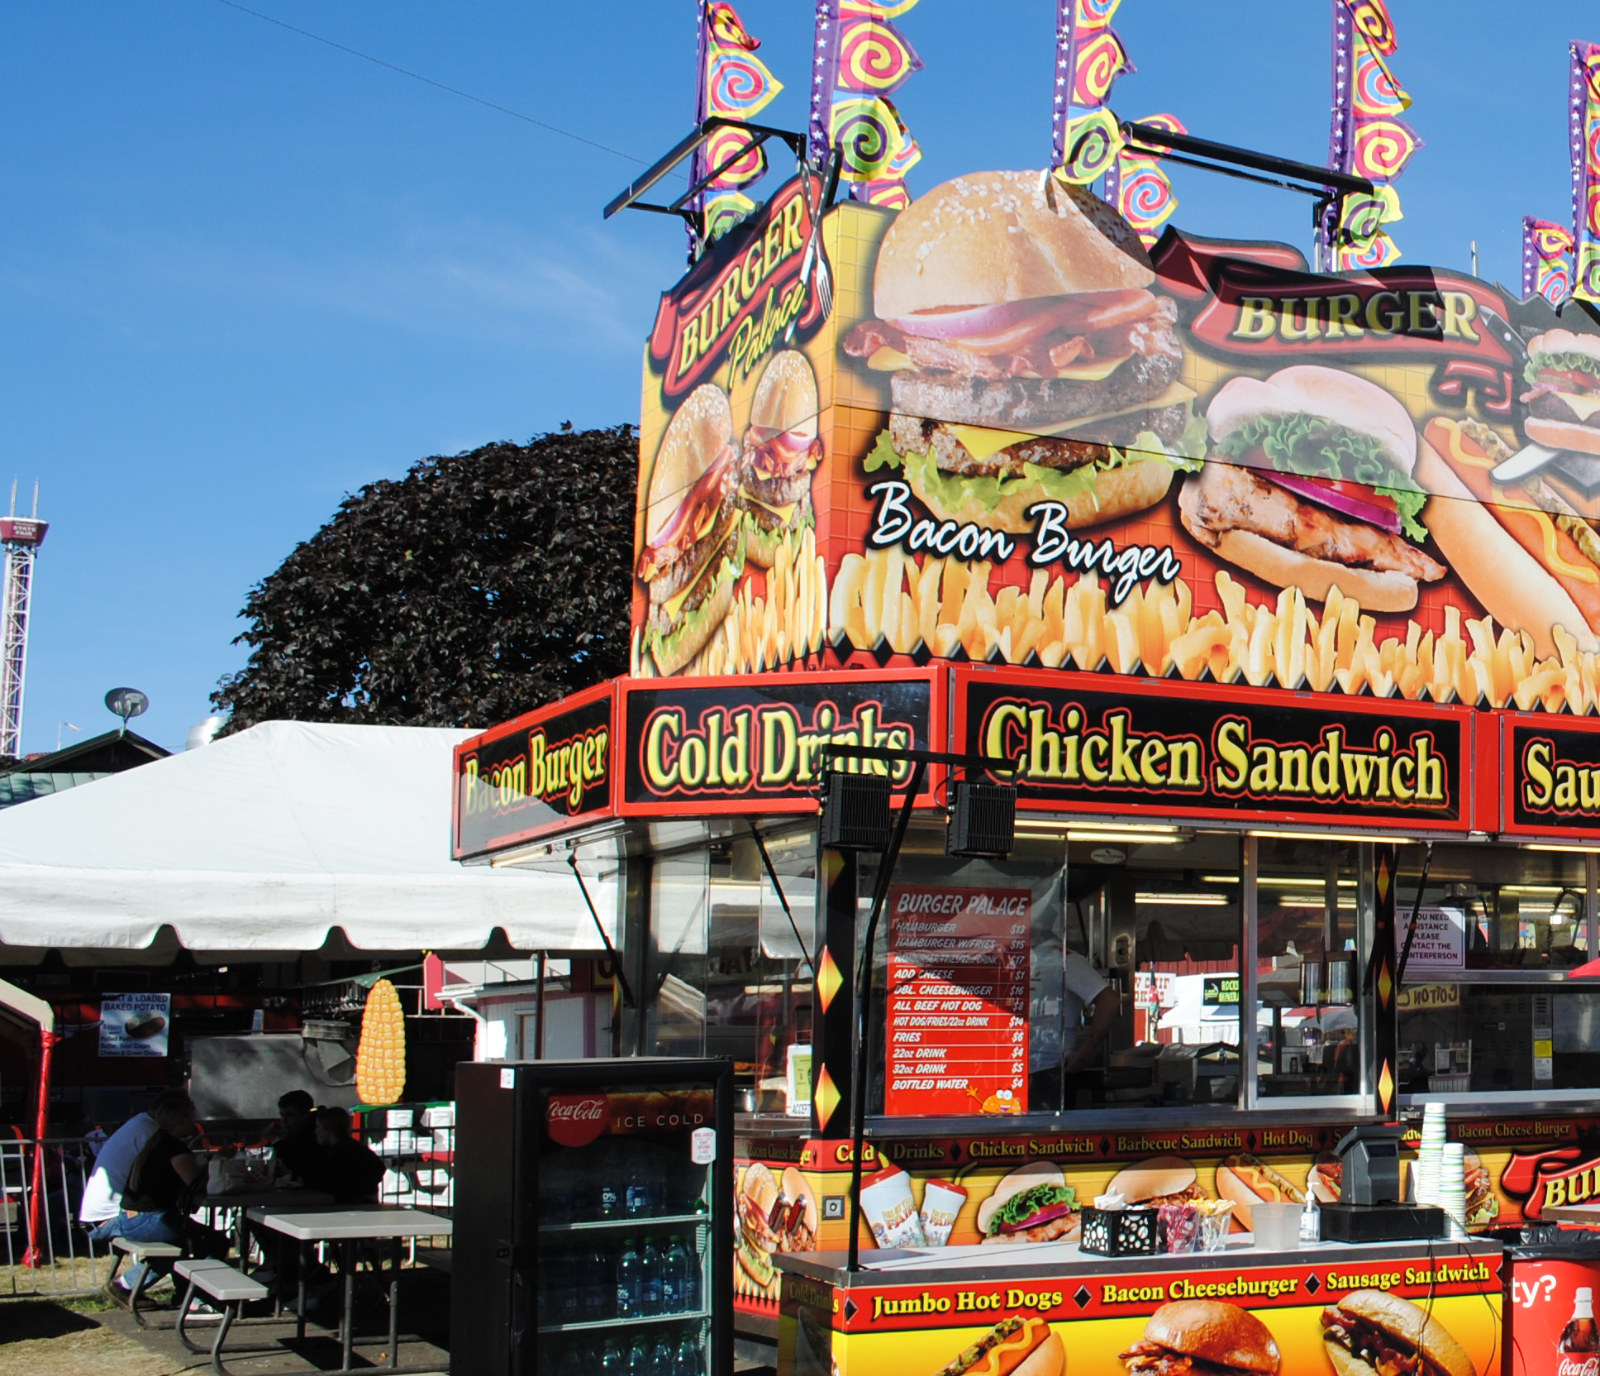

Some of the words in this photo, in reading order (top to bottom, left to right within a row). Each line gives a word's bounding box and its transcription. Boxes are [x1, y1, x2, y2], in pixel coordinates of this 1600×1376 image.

[678, 194, 804, 377] BURGER
[1232, 290, 1482, 342] BURGER
[728, 282, 807, 389] Palace
[870, 481, 1016, 559] Bacon
[1027, 503, 1181, 604] Burger
[646, 709, 750, 788] Cold
[761, 708, 907, 785] Drinks
[986, 704, 1200, 788] Chicken
[1216, 721, 1444, 801] Sandwich
[465, 757, 526, 817] Bacon
[530, 730, 608, 807] Burger
[897, 893, 963, 914] BURGER
[966, 896, 1029, 916] PALACE
[1403, 912, 1410, 920] IF
[1429, 913, 1449, 921] NEED
[896, 922, 957, 933] HAMBURGER
[1010, 924, 1026, 935] $13
[1403, 923, 1449, 931] AISTANCE
[895, 938, 959, 948] HAMBURGER
[958, 939, 996, 949] W/FRIES
[1413, 932, 1440, 940] PLEASE
[1400, 942, 1435, 950] CNTACT
[1438, 942, 1451, 950] THE
[1396, 952, 1458, 960] CONTERPERSON
[894, 969, 916, 979] ADD
[918, 969, 954, 980] CHEESE
[919, 985, 992, 996] CHEESEBURGER
[893, 1001, 911, 1010] ALL
[911, 1001, 940, 1010] BEEF
[941, 1001, 960, 1010] HOT
[961, 1001, 983, 1011] DOG
[893, 1017, 908, 1027] HOT
[966, 1017, 989, 1027] DRINK
[893, 1033, 921, 1042] FRIES
[1012, 1032, 1024, 1043] $6
[892, 1049, 914, 1058] 22oz
[915, 1048, 947, 1058] DRINK
[1012, 1047, 1024, 1059] $4
[892, 1064, 914, 1074] 32oz
[915, 1064, 947, 1074] DRINK
[1011, 1063, 1024, 1074] $5
[892, 1079, 935, 1091] BOTTLED
[936, 1079, 969, 1090] WATER
[1012, 1078, 1024, 1090] $4
[546, 1099, 607, 1122] Coca-Cola
[617, 1115, 646, 1128] ICE
[656, 1113, 704, 1126] COLD
[1457, 1123, 1492, 1138] Bacon
[1495, 1123, 1531, 1137] Cheese
[1534, 1121, 1570, 1139] Burger
[1117, 1137, 1179, 1151] Barbecue
[1181, 1134, 1242, 1149] Sandwich
[1262, 1132, 1286, 1146] Hot
[1289, 1131, 1313, 1148] Dog
[892, 1142, 945, 1159] Drinks
[969, 1142, 1026, 1158] Chicken
[1029, 1139, 1094, 1154] Sandwich
[1326, 1262, 1401, 1291] Sausage
[1404, 1261, 1490, 1285] Sandwich
[1102, 1282, 1164, 1303] Bacon
[1168, 1273, 1298, 1301] Cheeseburger
[872, 1293, 950, 1321] Jumbo
[956, 1292, 1002, 1313] Hot
[1005, 1287, 1063, 1311] Dogs
